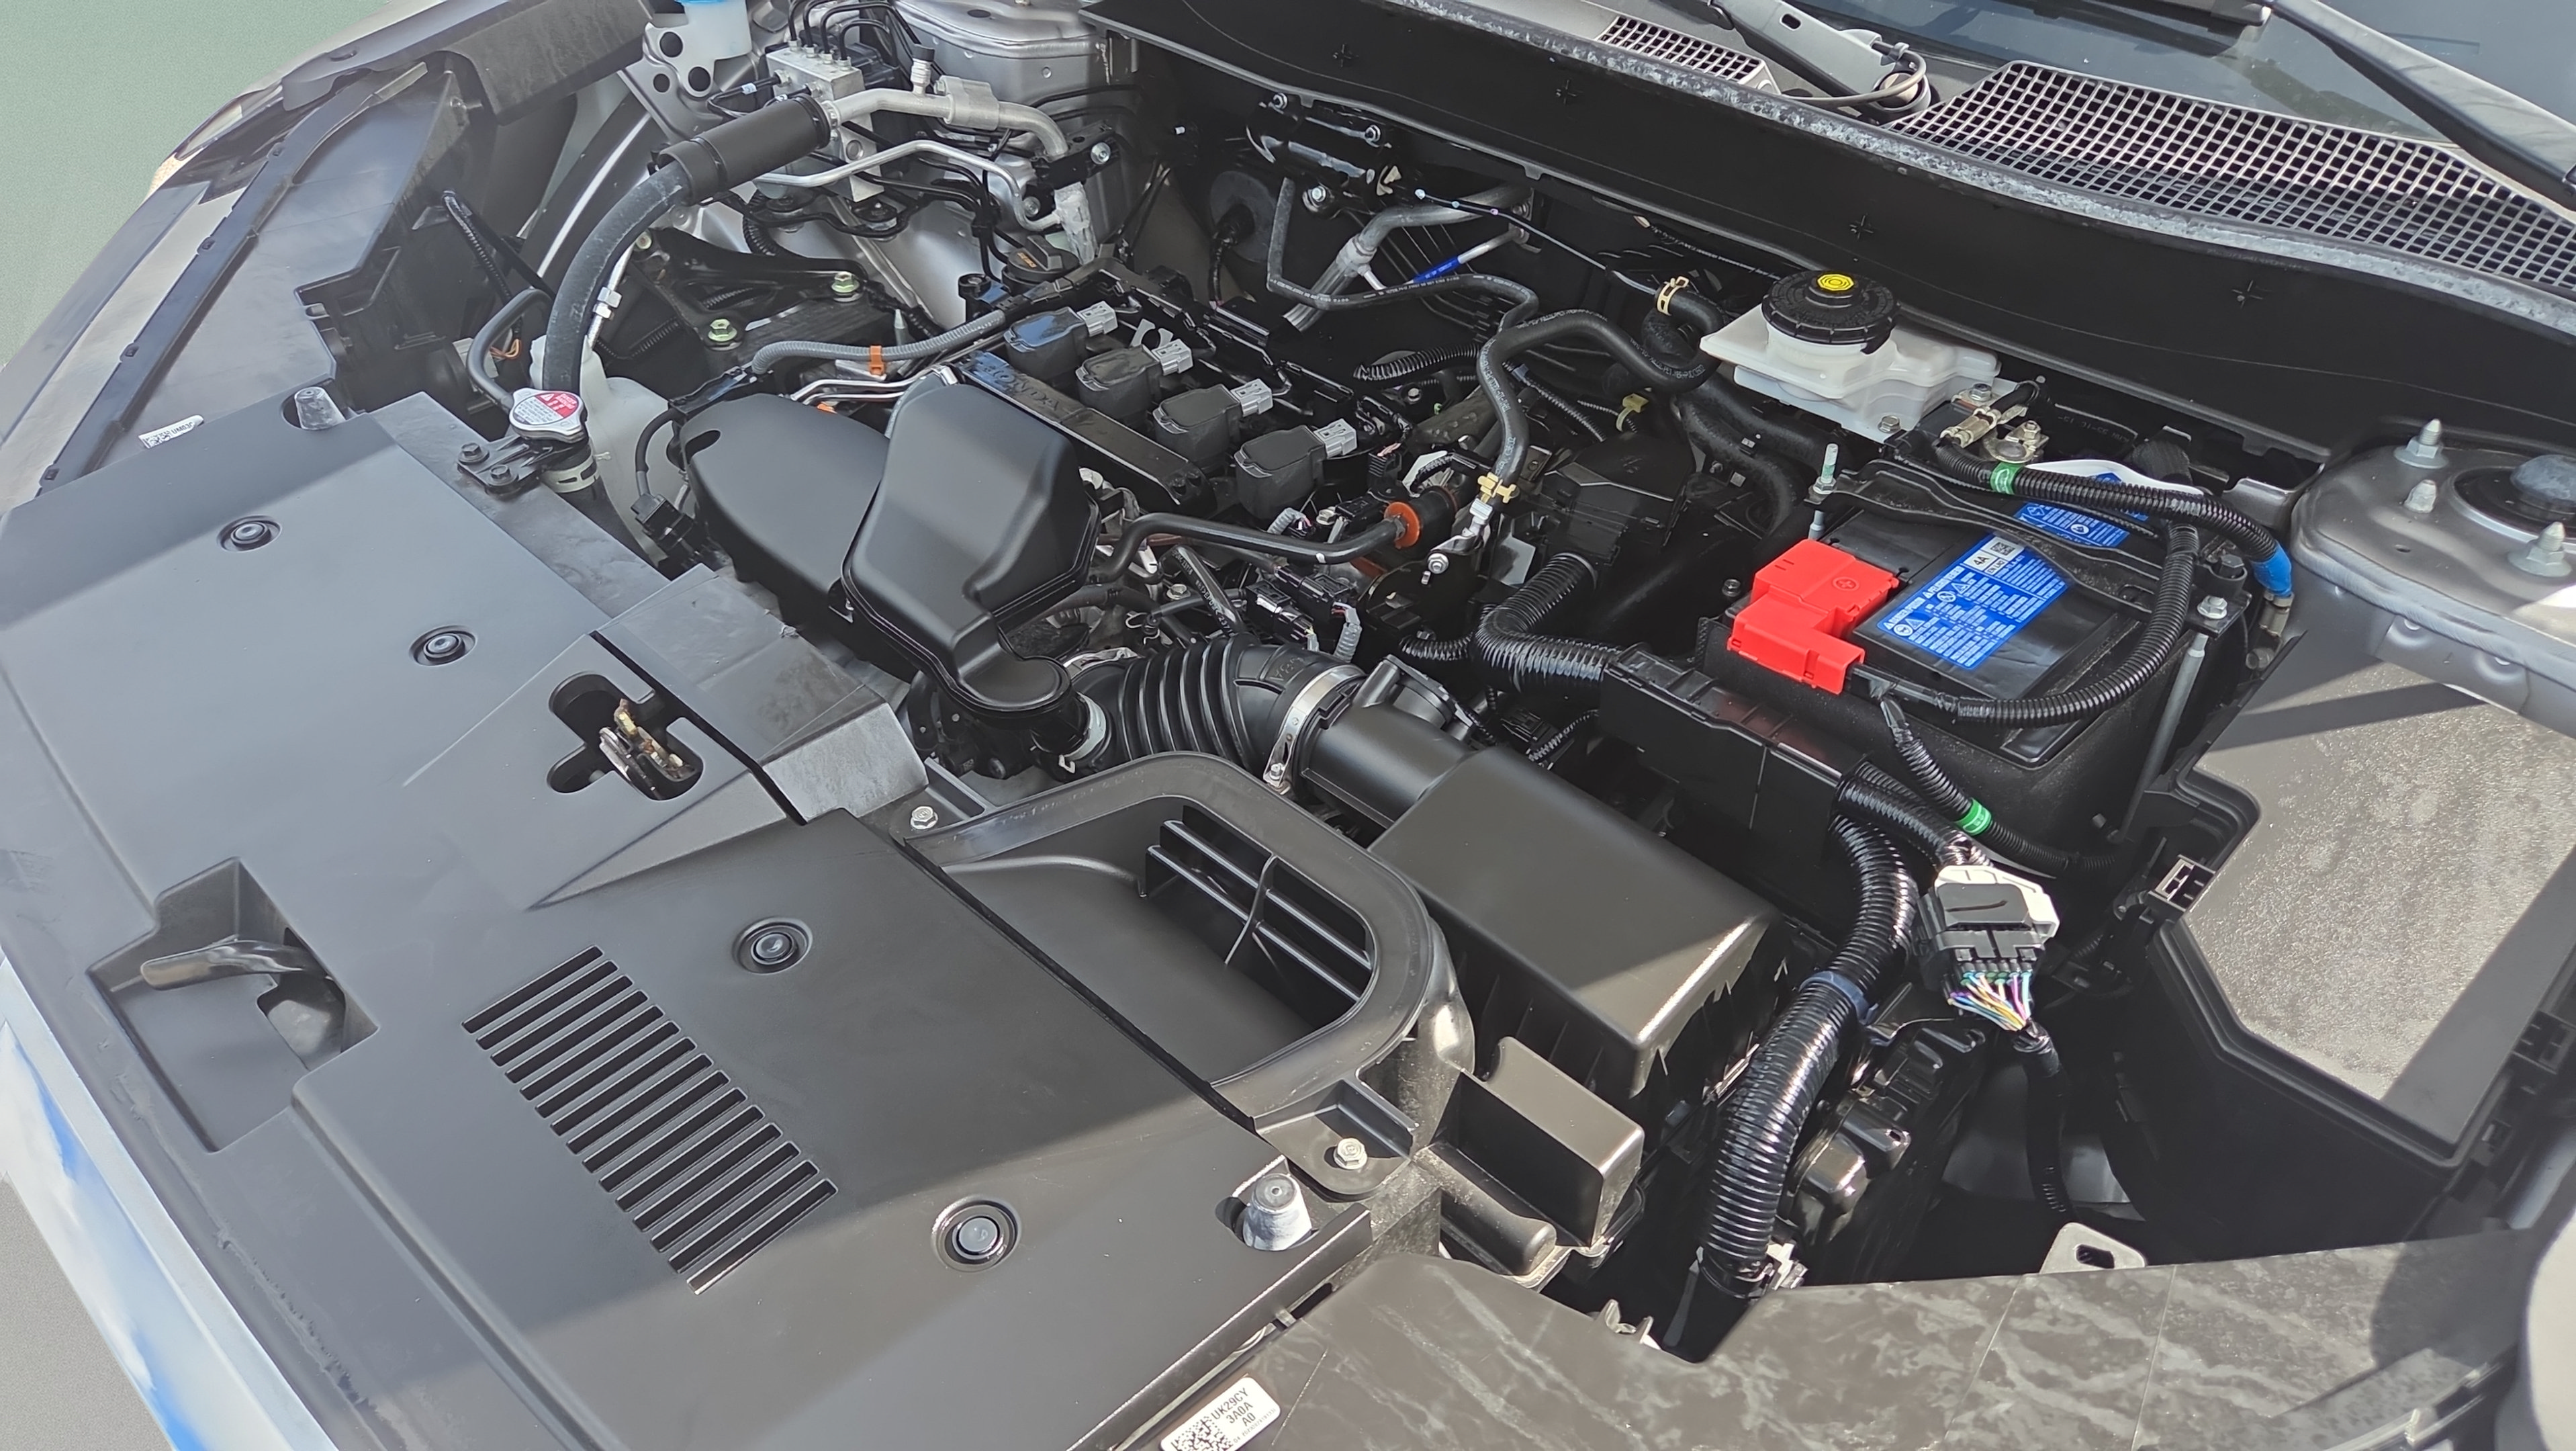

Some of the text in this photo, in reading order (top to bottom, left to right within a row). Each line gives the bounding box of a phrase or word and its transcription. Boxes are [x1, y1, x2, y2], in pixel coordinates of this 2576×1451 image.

[984, 364, 1059, 411] HONDA
[1973, 554, 1990, 566] 4A
[1211, 1388, 1248, 1419] UK29CY
